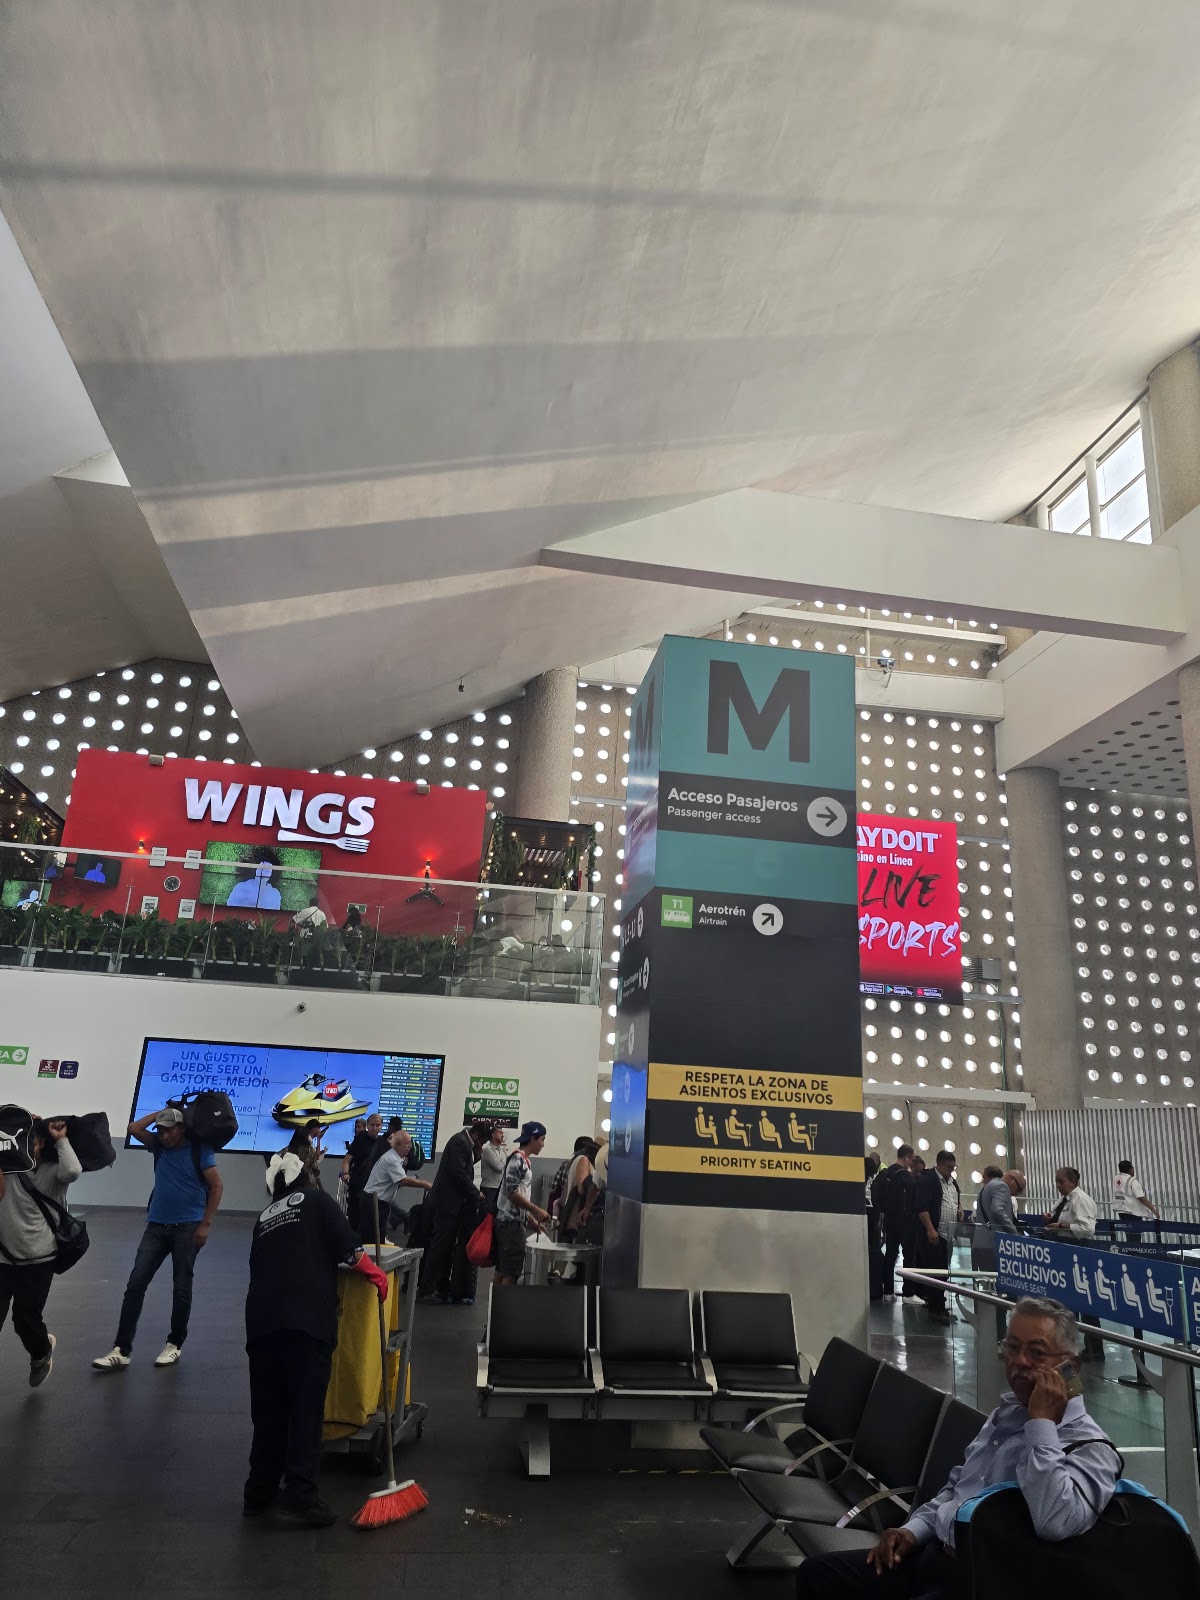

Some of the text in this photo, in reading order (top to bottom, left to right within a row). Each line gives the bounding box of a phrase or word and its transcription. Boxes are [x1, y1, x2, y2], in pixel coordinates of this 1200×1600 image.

[707, 659, 810, 763] M
[185, 778, 376, 836] WINGS
[667, 787, 798, 812] Acceso Pasajeros
[667, 806, 761, 824] Passenger access
[877, 854, 887, 864] en
[890, 852, 913, 866] Línea
[861, 865, 941, 908] LIVE
[699, 904, 746, 917] Aerotrén
[699, 917, 727, 926] Airtrain
[858, 913, 959, 957] SPORTS
[181, 1051, 256, 1064] UN GUSTITO
[171, 1062, 262, 1076] PUEDE SER UN
[161, 1072, 270, 1088] GASTOTE. MEJOR
[484, 1082, 503, 1090] DEA
[685, 1071, 829, 1091] RESPETA LA ZONA DE
[486, 1099, 501, 1107] DEA
[680, 1085, 834, 1105] ASIENTOS EXCLUSIVOS
[700, 1156, 812, 1172] PRIORITY SEATING
[999, 1239, 1051, 1264] ASIENTOS
[1000, 1257, 1067, 1289] EXCLUSIVOS
[1001, 1275, 1047, 1296] EXCLUSIVE SEATS
